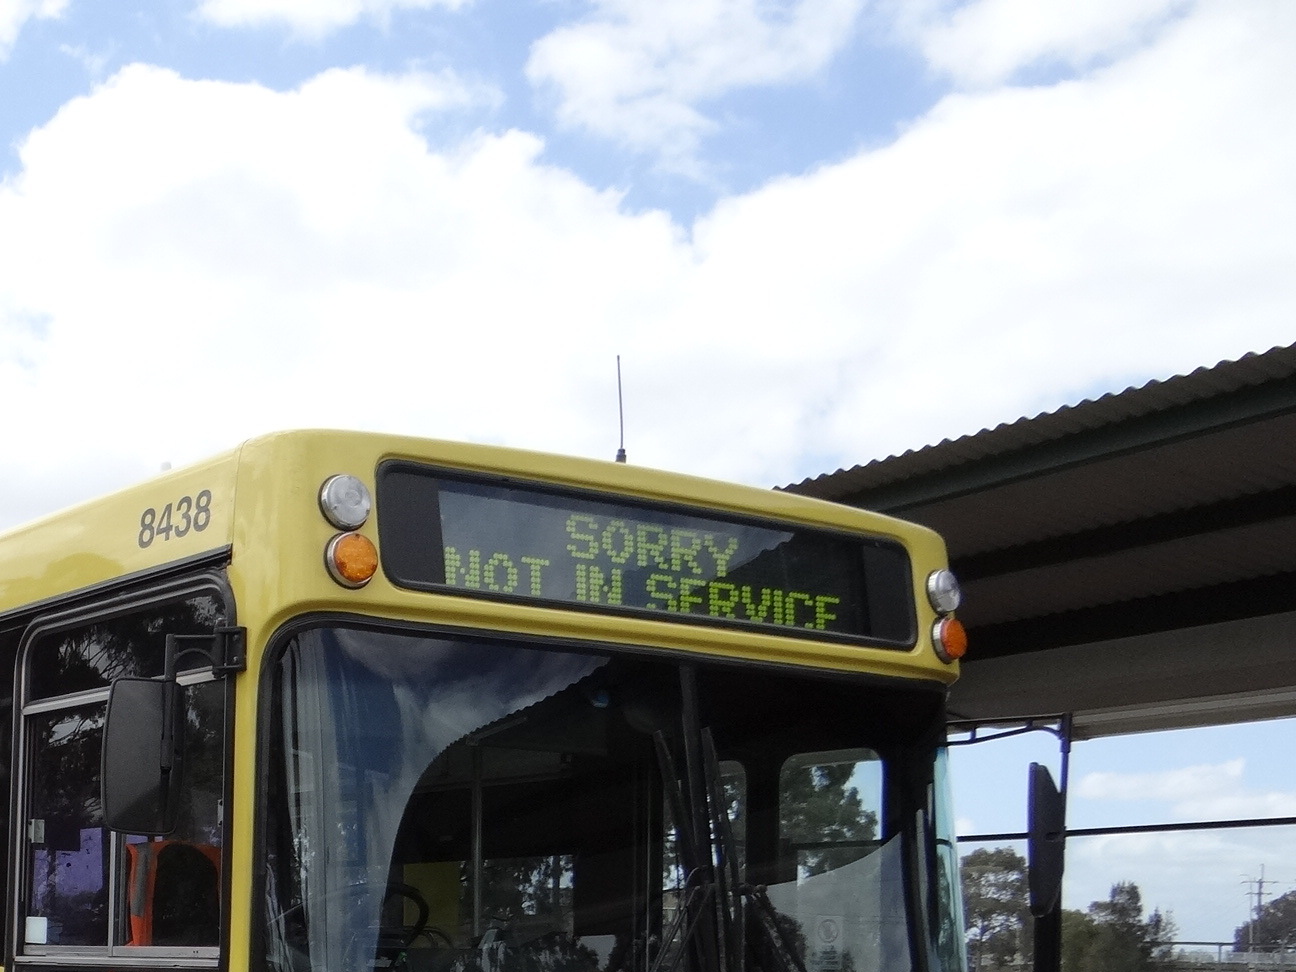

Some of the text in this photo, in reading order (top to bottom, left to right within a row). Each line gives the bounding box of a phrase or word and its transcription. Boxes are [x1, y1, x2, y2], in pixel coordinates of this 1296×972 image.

[138, 489, 212, 549] 8438
[566, 514, 738, 577] SORRY
[445, 547, 840, 631] NOT IN SERVICE
